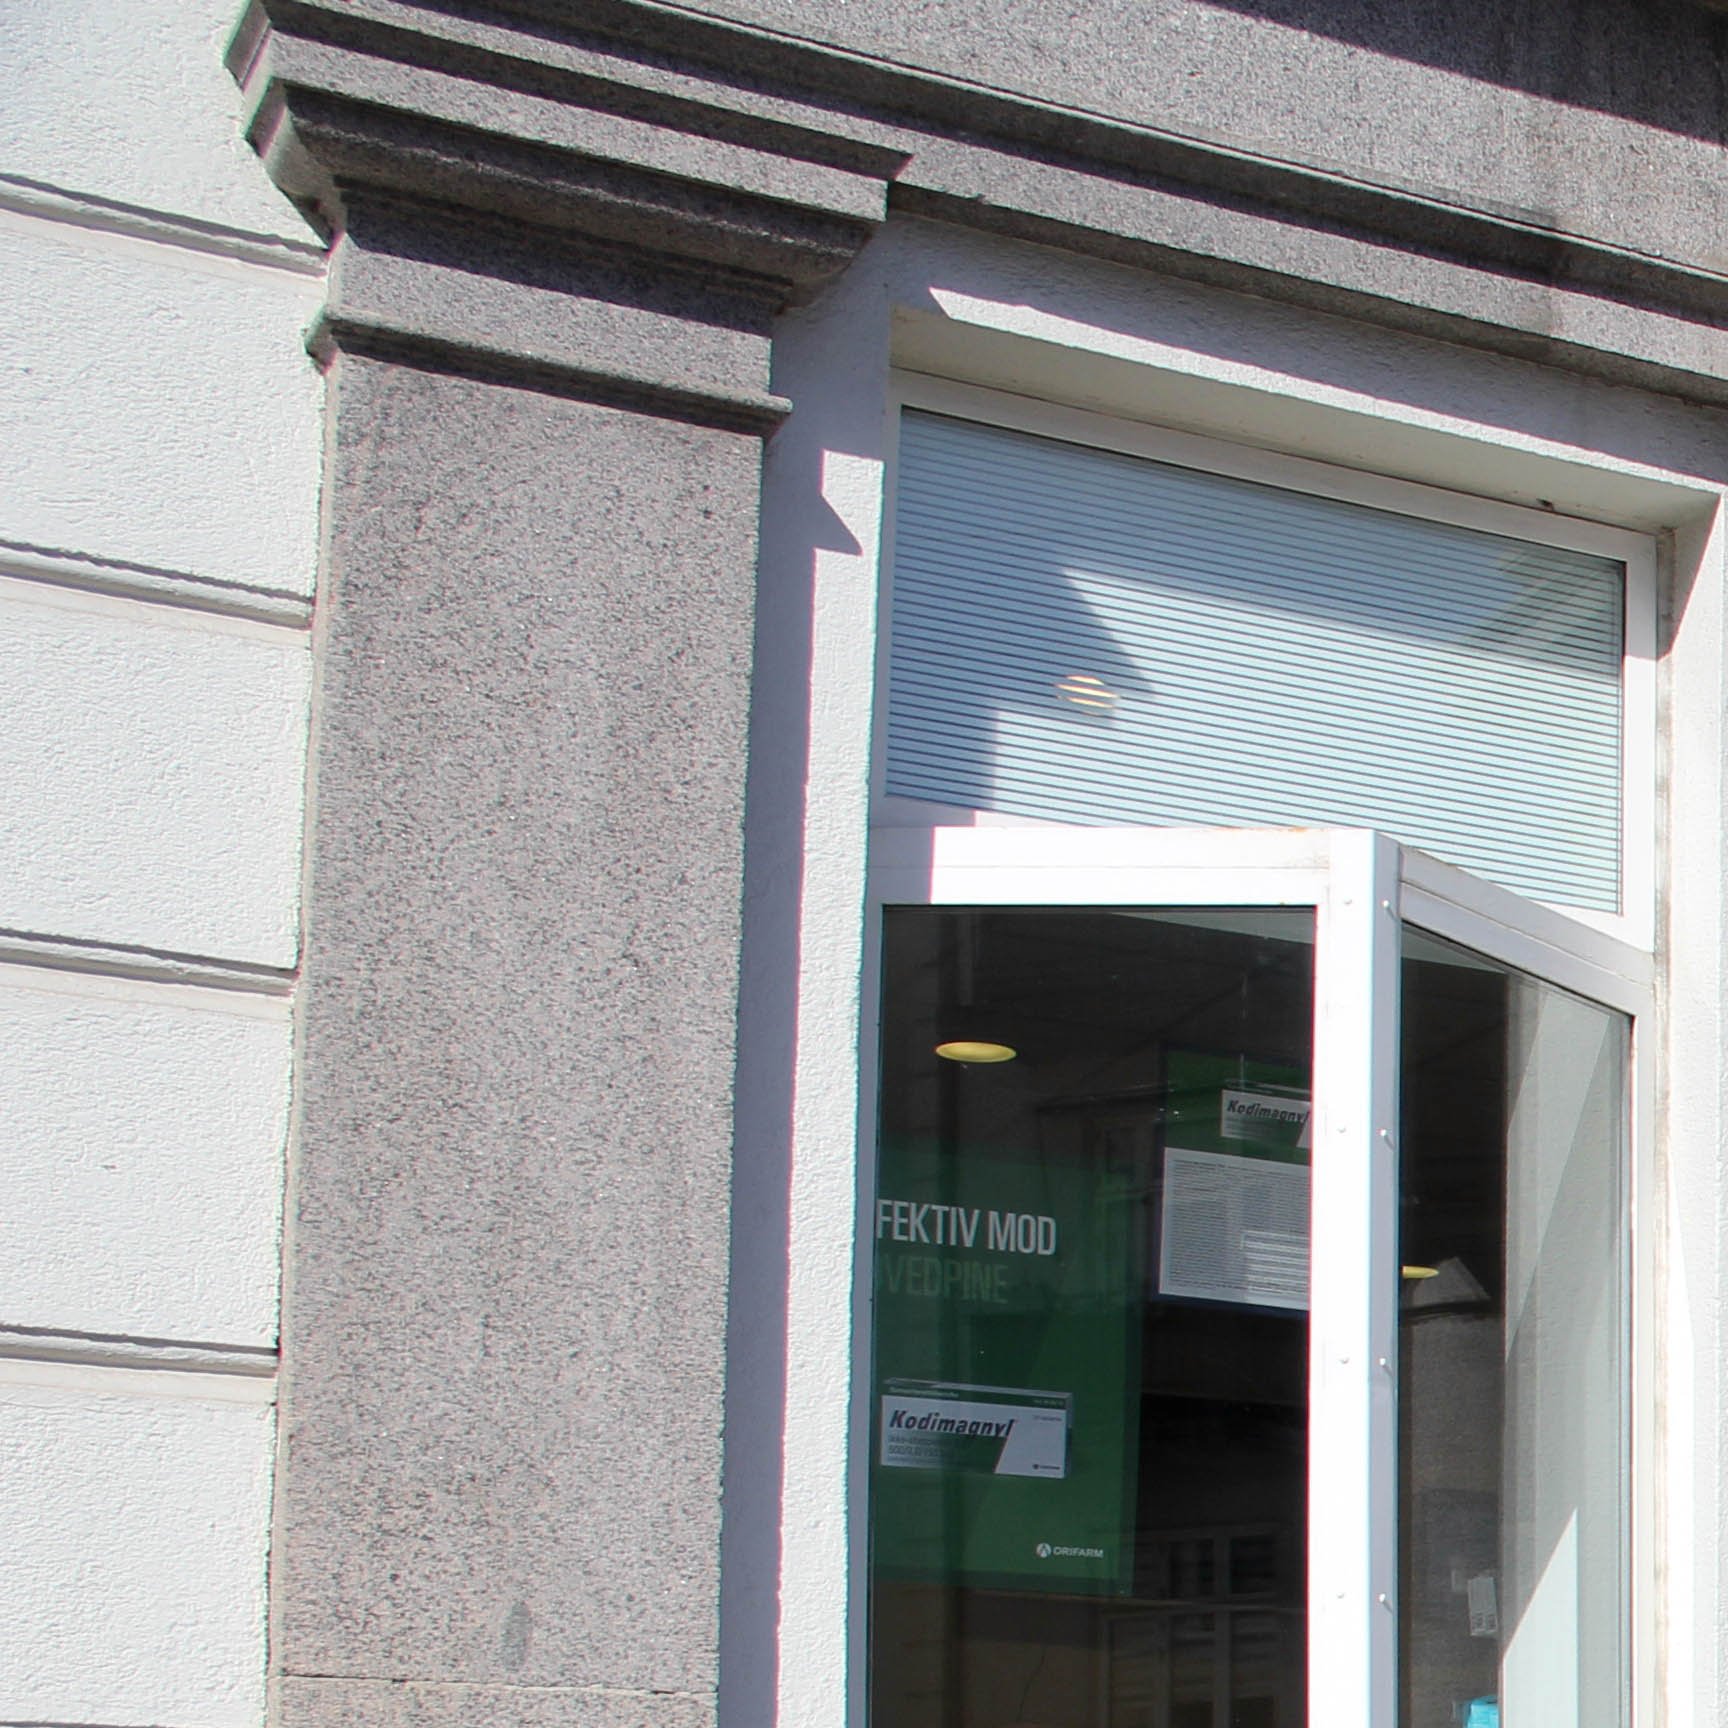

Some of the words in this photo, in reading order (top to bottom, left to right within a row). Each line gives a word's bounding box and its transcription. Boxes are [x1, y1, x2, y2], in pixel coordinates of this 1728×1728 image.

[876, 1198, 980, 1249] FEKTIV
[988, 1209, 1057, 1256] MOD
[889, 1409, 1017, 1440] Kodimagnyl
[1053, 1545, 1105, 1559] ORIFARM
